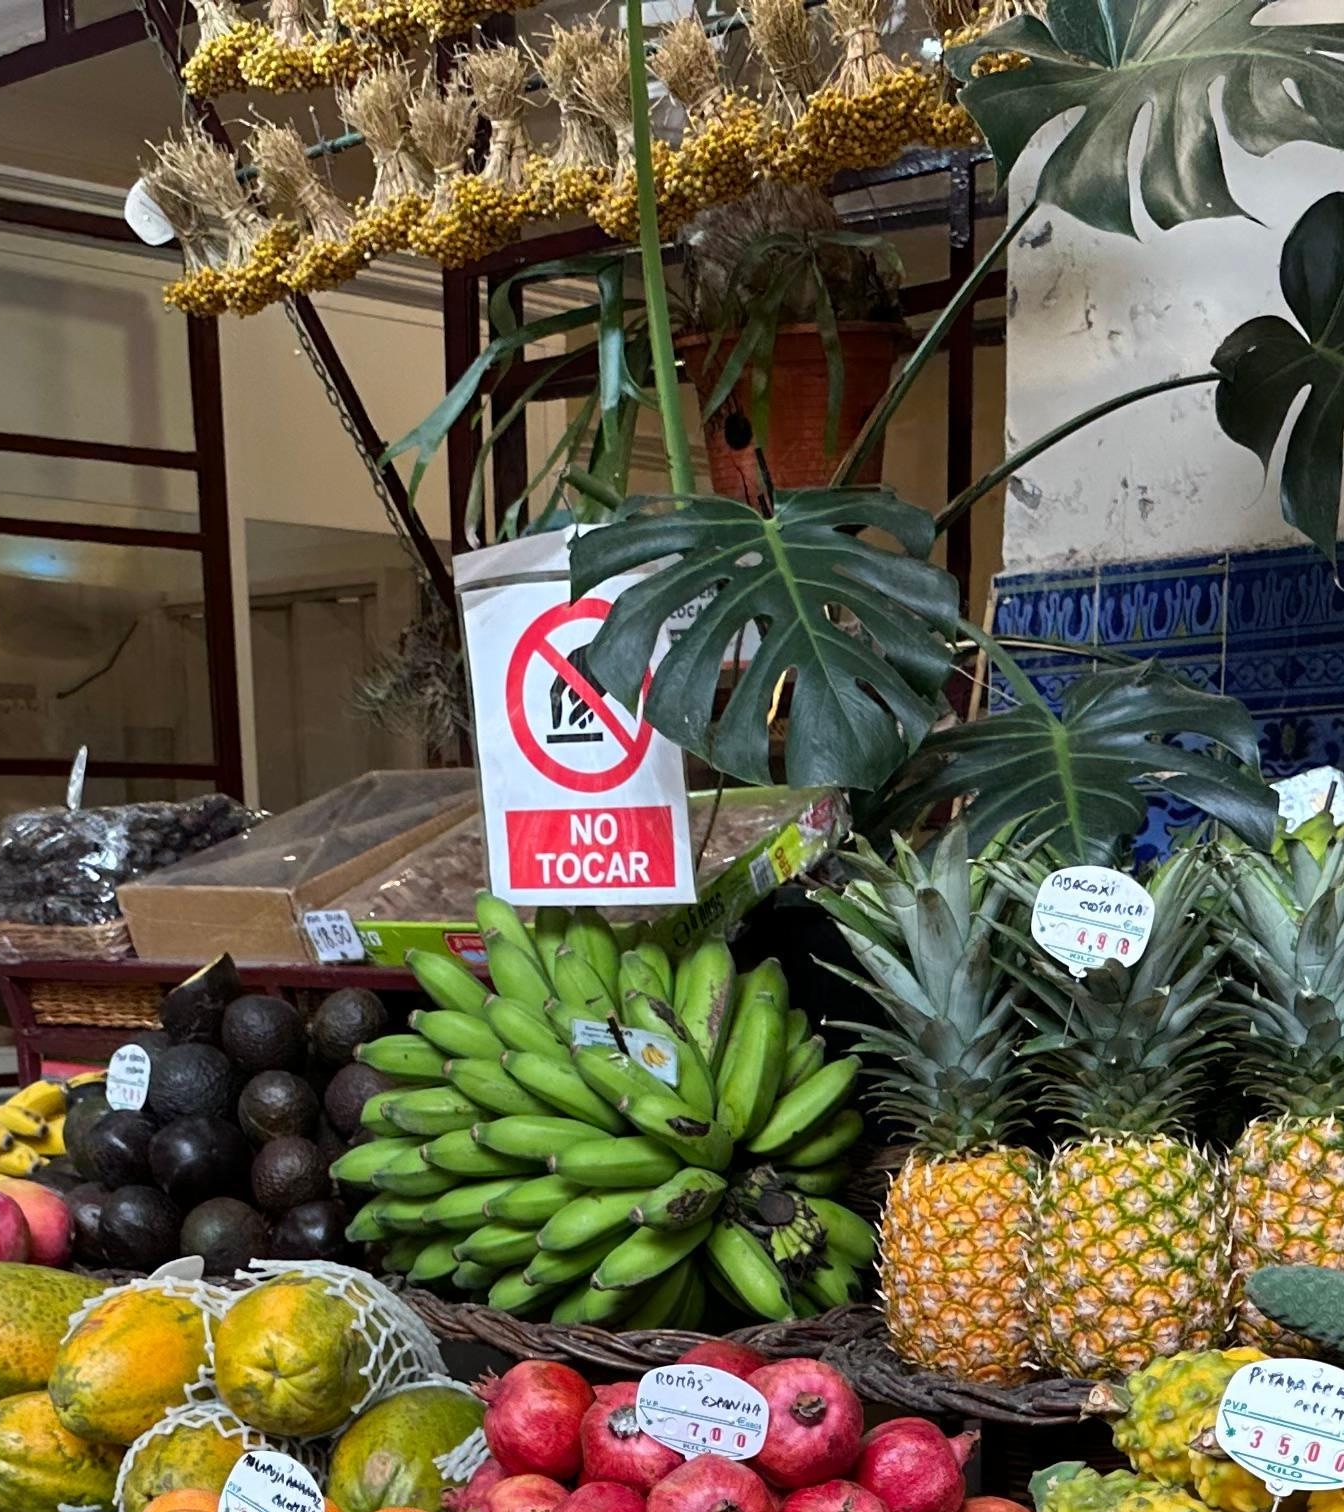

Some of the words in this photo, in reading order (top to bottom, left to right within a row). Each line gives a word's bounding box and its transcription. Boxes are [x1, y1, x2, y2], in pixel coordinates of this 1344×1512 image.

[570, 813, 618, 846] NO
[535, 851, 651, 885] TOCAR
[1077, 930, 1131, 956] 4,98
[655, 1369, 705, 1393] ROMÃS
[687, 1422, 747, 1449] 7,00
[1266, 1463, 1304, 1480] KILO
